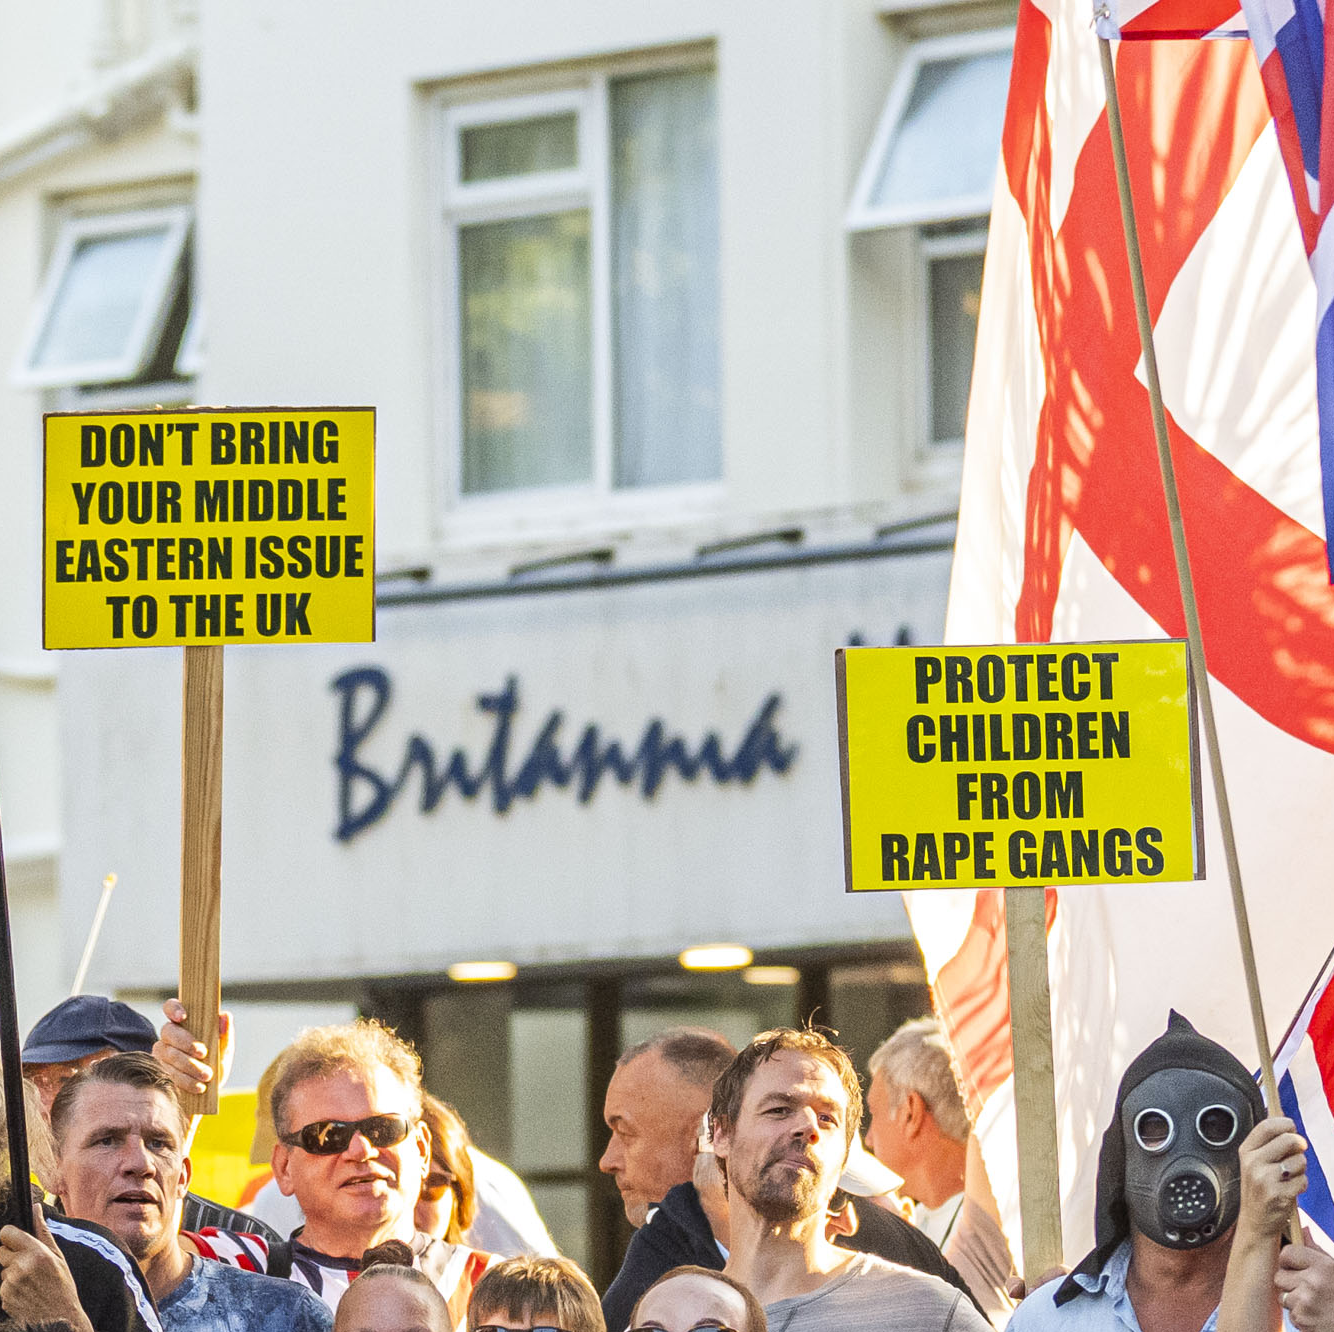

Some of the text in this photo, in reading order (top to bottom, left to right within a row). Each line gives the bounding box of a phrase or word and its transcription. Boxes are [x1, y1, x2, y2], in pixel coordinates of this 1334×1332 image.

[80, 419, 339, 468] DON'T BRING
[72, 477, 347, 525] YOUR MIDDLE
[55, 534, 364, 583] EASTERN ISSUE
[105, 592, 312, 639] TO THE UK
[914, 652, 1120, 705] PROTECT
[328, 664, 800, 845] Britannia
[906, 711, 1131, 764] CHILDREN
[956, 770, 1084, 821] FROM
[881, 826, 1165, 883] RAPE GANGS
